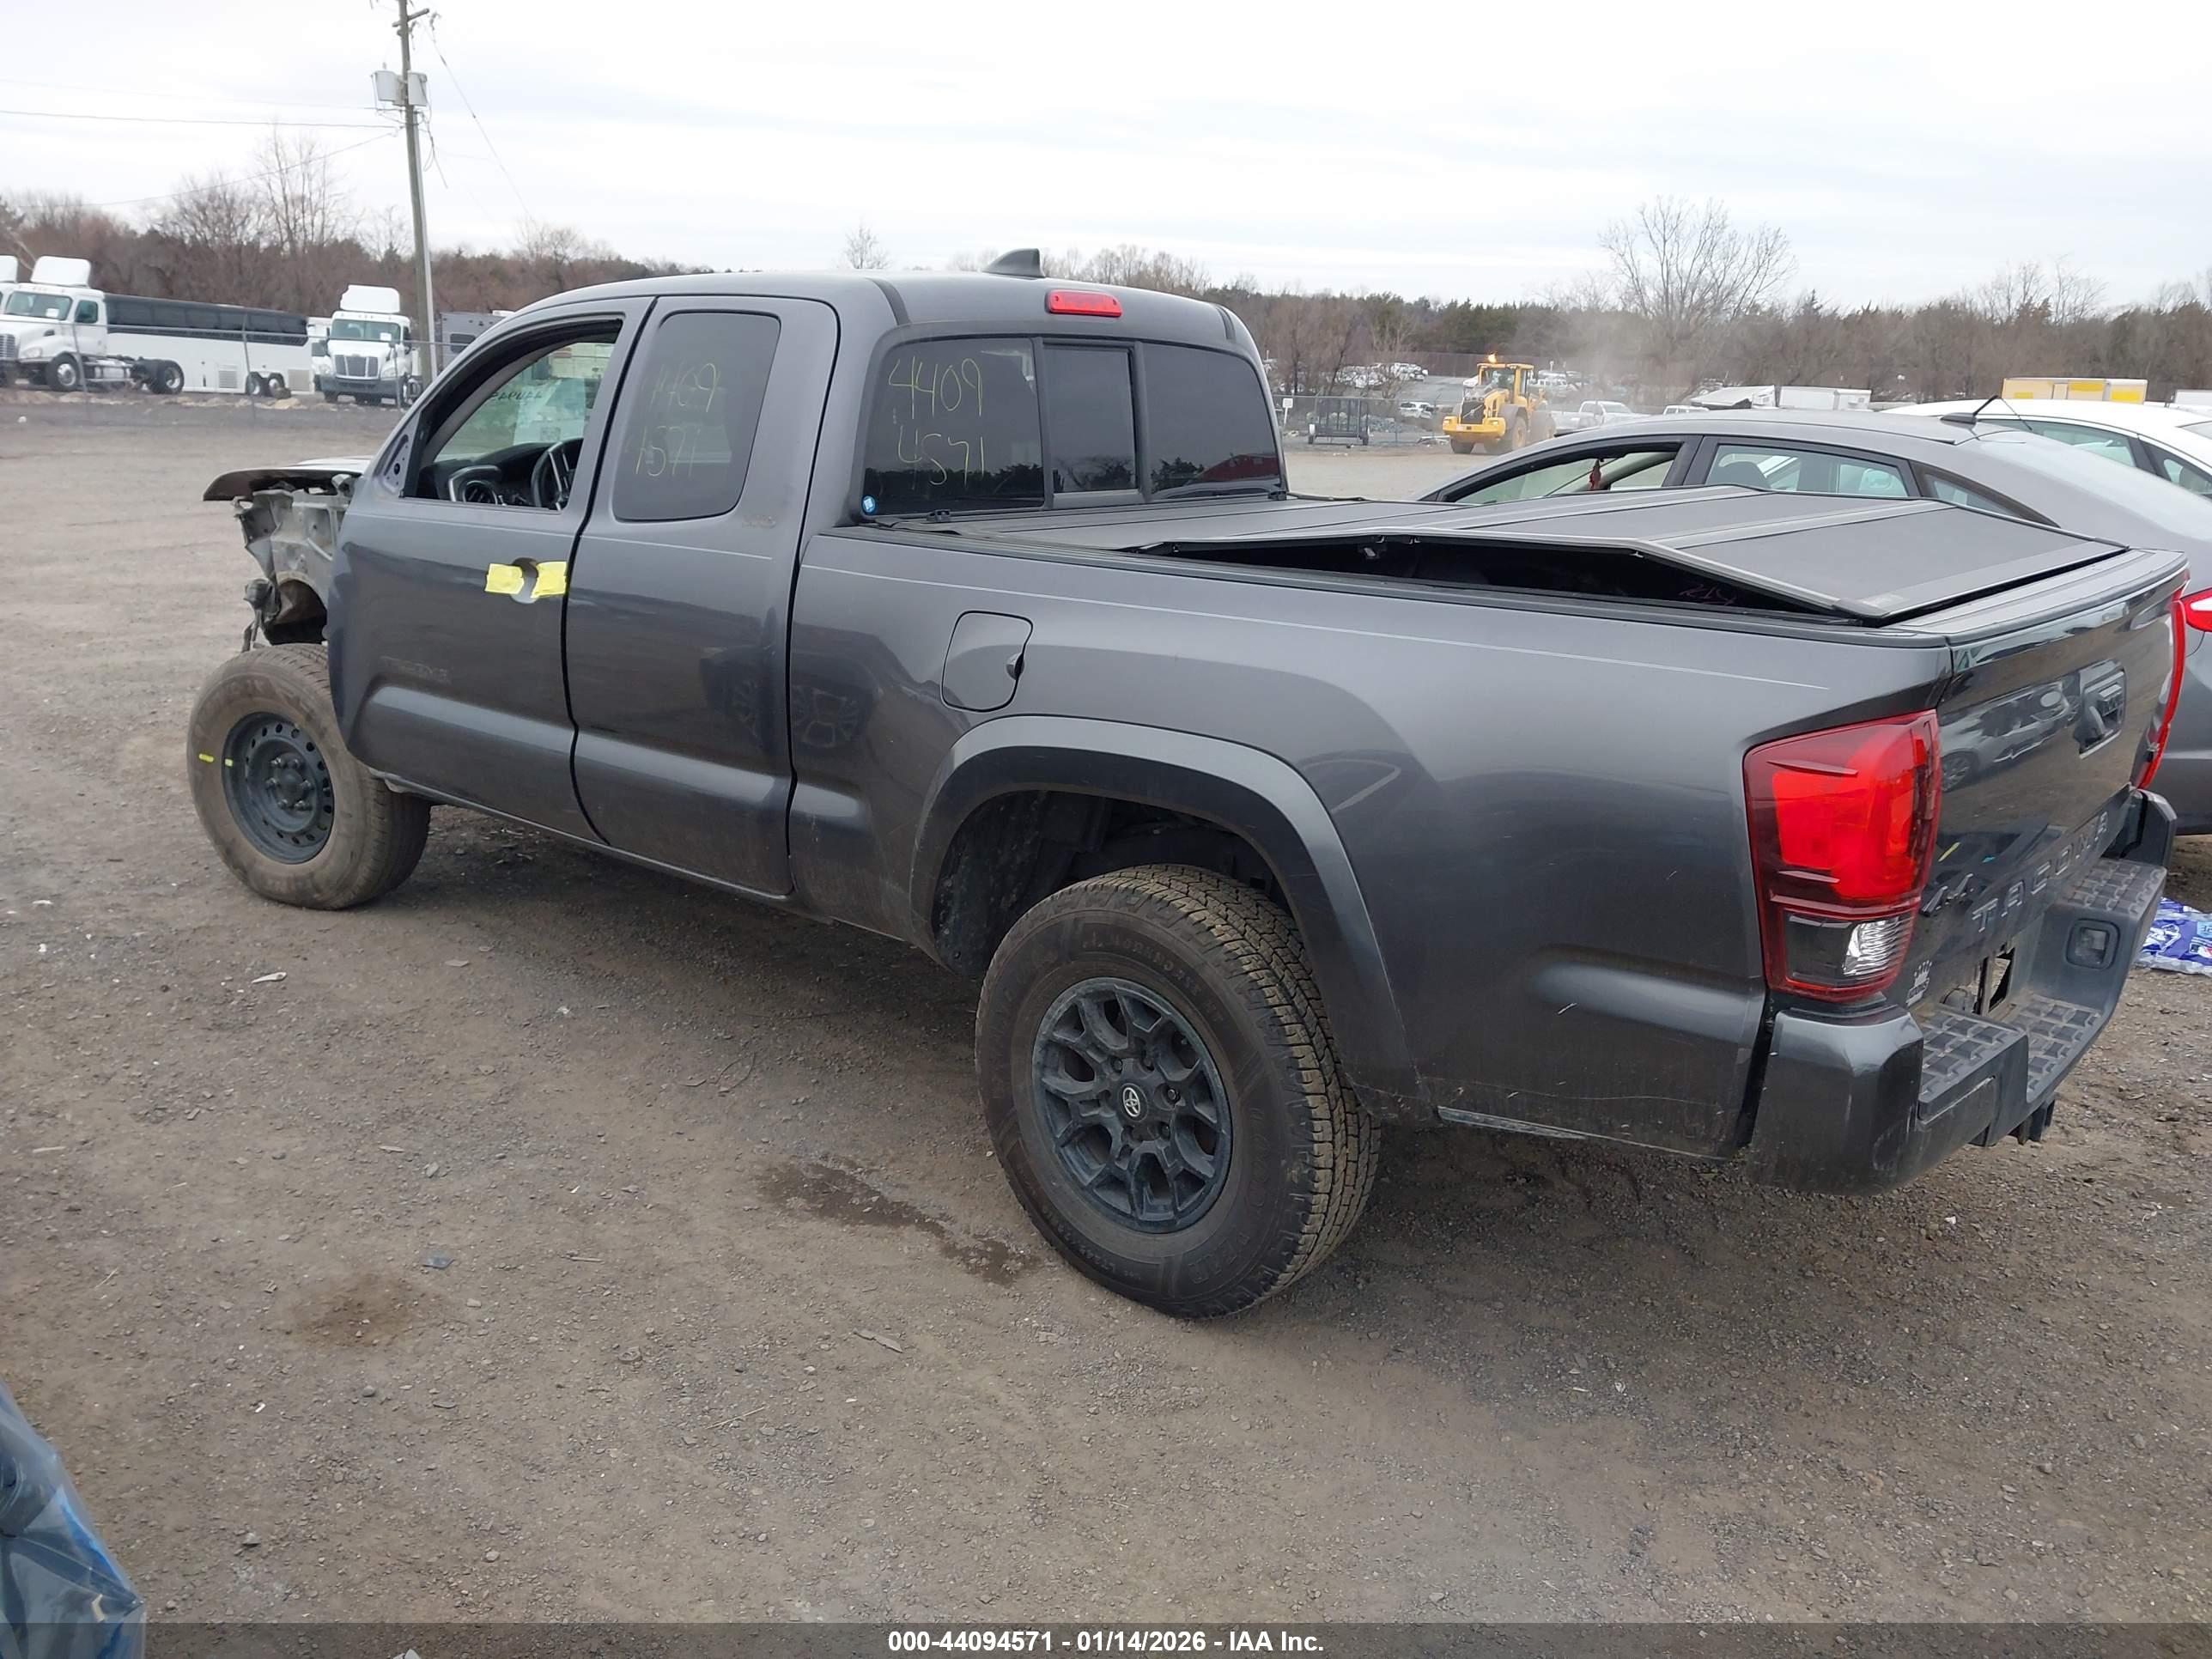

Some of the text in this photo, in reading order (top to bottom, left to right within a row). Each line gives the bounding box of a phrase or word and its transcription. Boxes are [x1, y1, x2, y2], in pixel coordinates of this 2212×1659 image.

[888, 356, 983, 419] 4409
[898, 425, 985, 490] 4571
[1972, 811, 2109, 933] TACOMA
